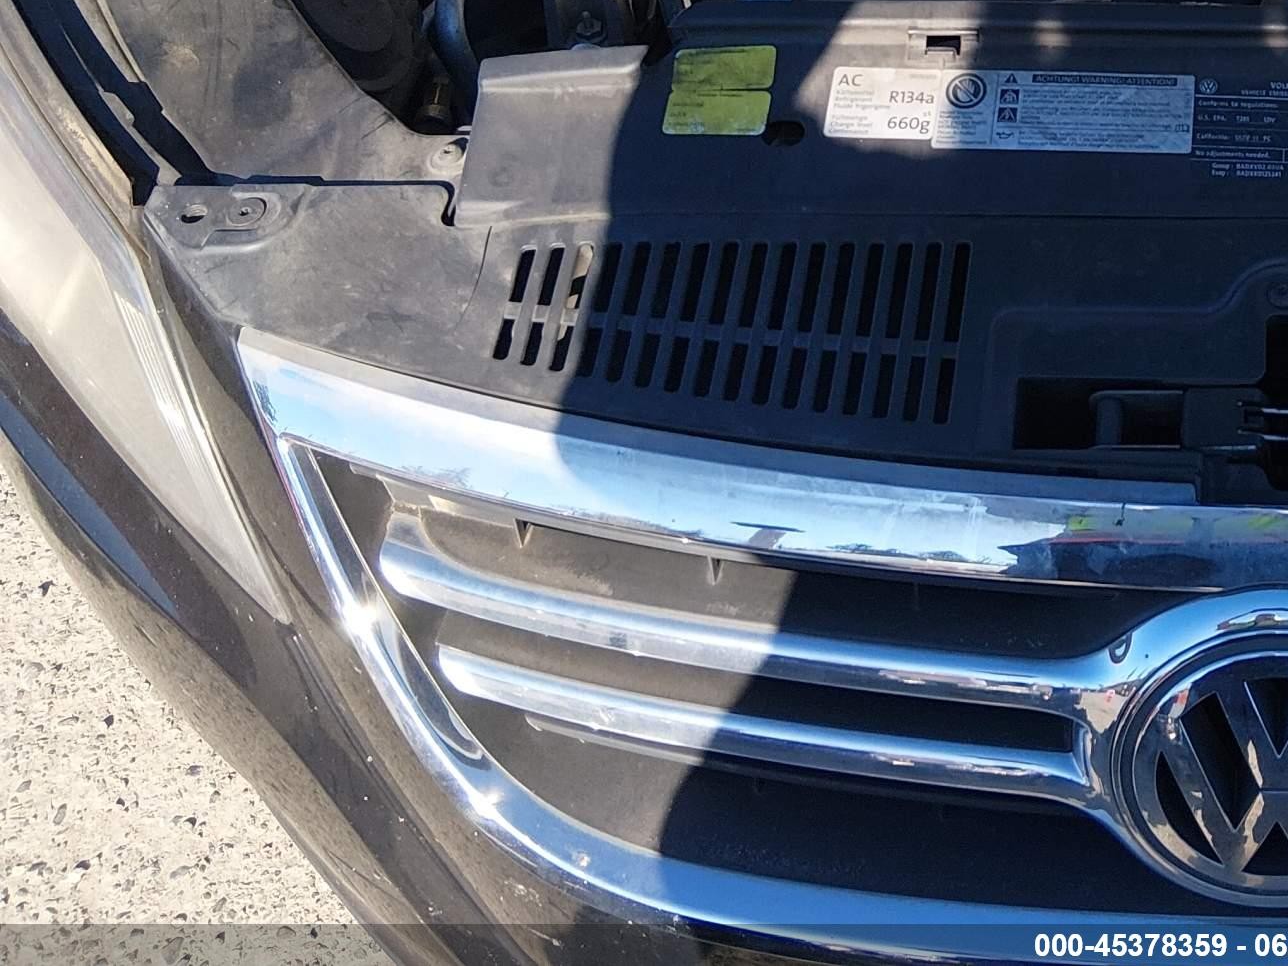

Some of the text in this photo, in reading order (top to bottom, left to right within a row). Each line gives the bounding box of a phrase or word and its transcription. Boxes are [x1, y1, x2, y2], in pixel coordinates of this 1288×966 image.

[838, 73, 864, 86] AC
[889, 90, 935, 104] R134a
[887, 116, 931, 134] 660g
